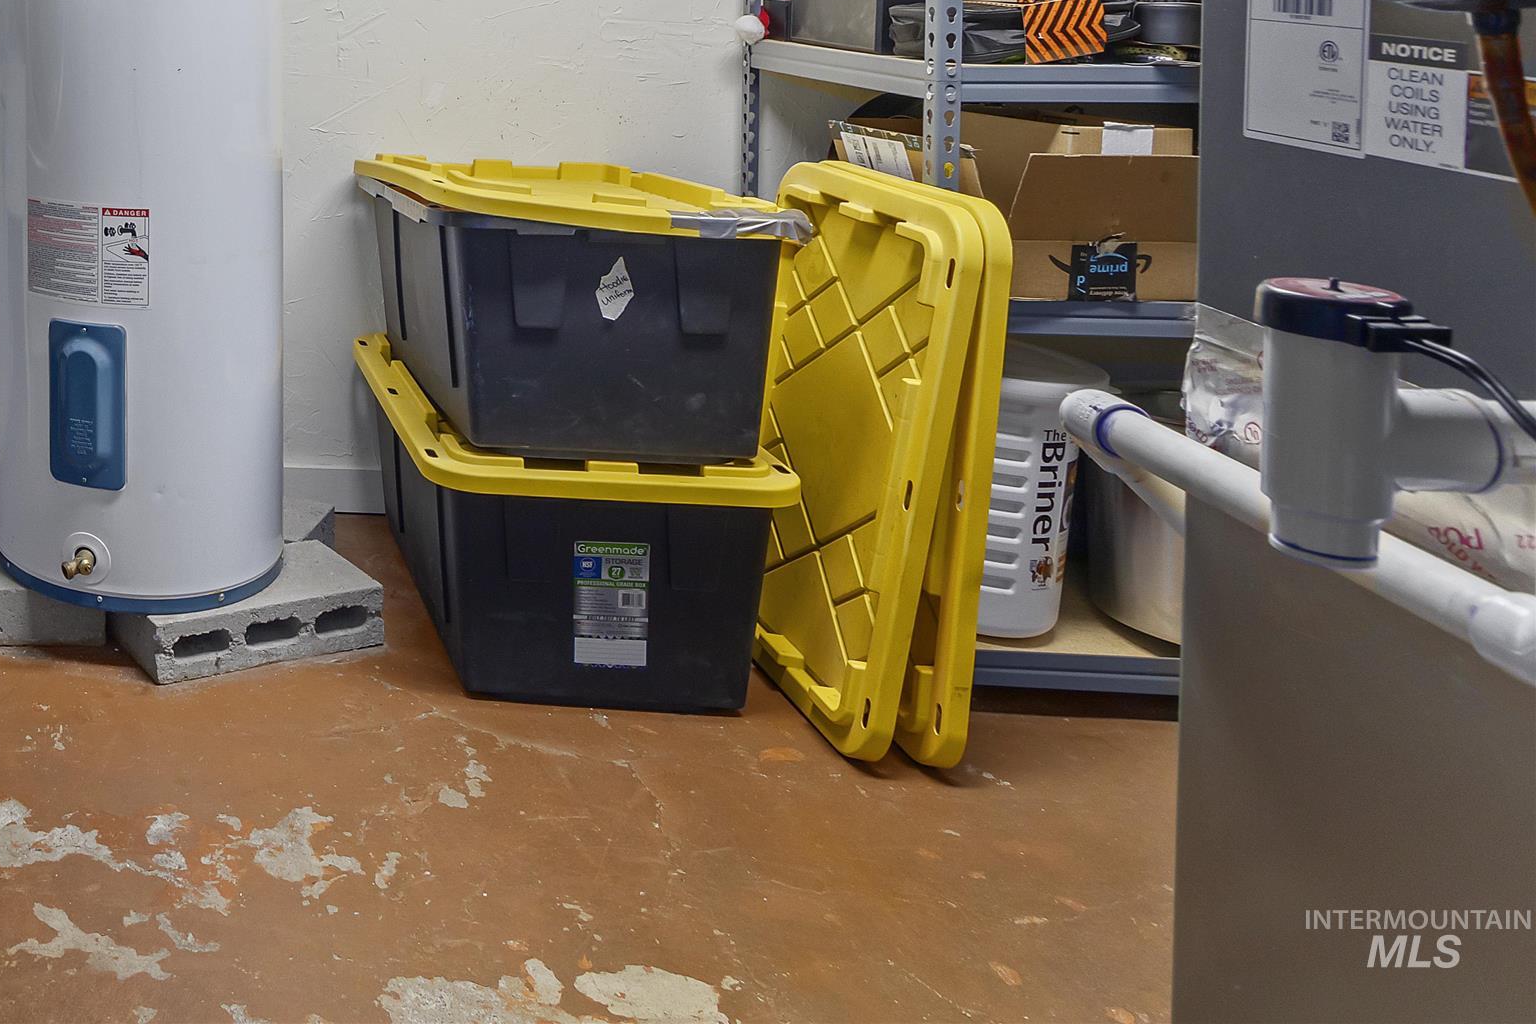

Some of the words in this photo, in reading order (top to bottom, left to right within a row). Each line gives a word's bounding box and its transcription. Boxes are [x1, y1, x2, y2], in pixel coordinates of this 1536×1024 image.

[1381, 42, 1457, 64] NOTICE
[1387, 67, 1444, 86] CLEAN
[1390, 84, 1440, 103] COILS
[1388, 101, 1440, 120] USING
[1384, 116, 1443, 138] WATER
[1389, 134, 1437, 154] ONLY.
[112, 209, 147, 217] DANGER
[1089, 261, 1128, 275] prime
[1043, 429, 1067, 442] The
[1031, 441, 1066, 552] Briner
[611, 567, 621, 576] 27
